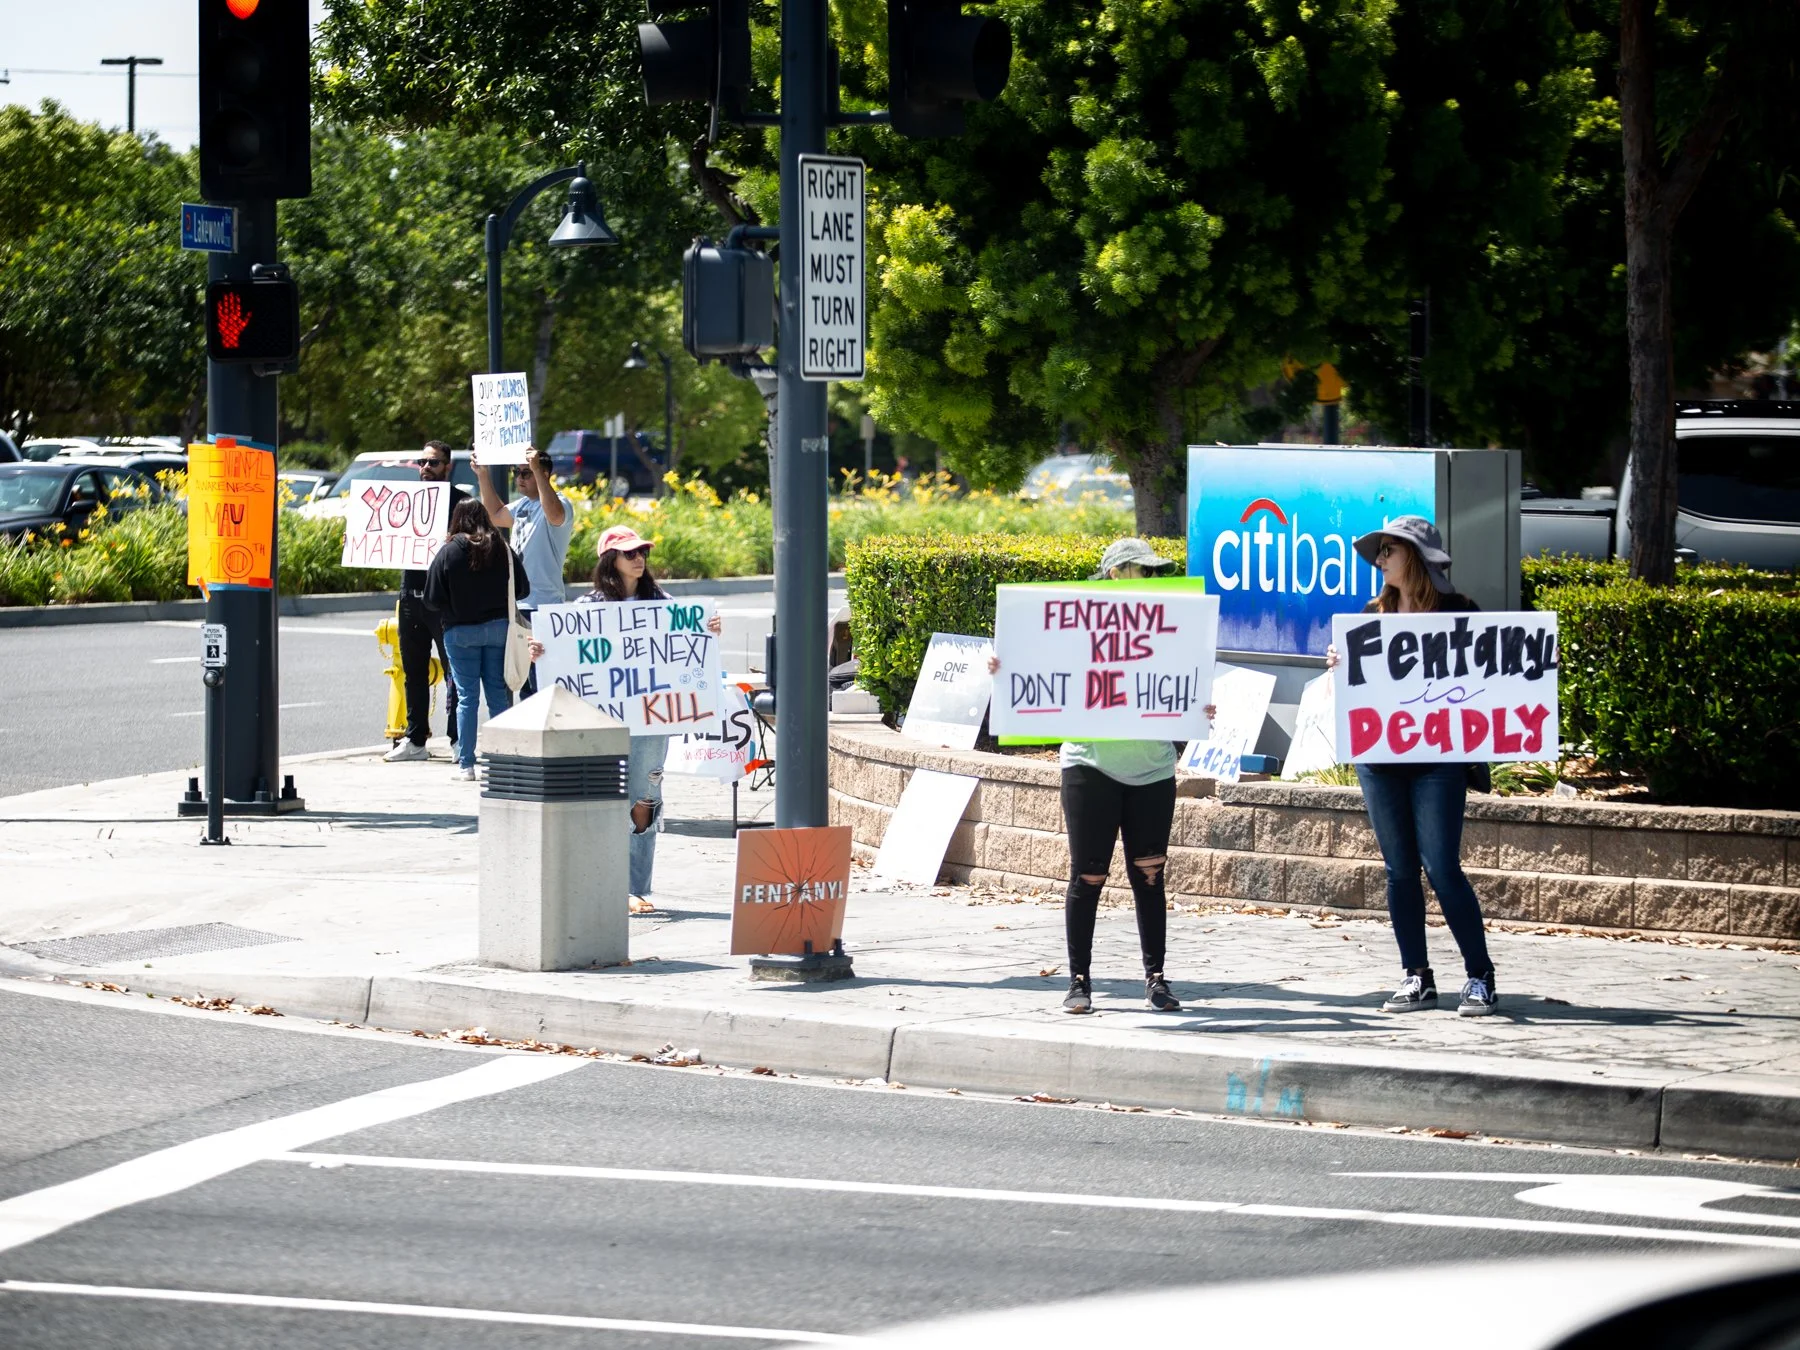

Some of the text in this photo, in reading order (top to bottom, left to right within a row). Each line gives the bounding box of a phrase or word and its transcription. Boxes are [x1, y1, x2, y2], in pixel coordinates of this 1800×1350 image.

[808, 168, 856, 200] RIGHT
[193, 211, 224, 245] Lakewood
[811, 211, 854, 242] LANE
[811, 254, 854, 284] MUST
[812, 296, 854, 326] TURN
[809, 338, 856, 368] RIGHT
[479, 381, 494, 399] OUR
[504, 401, 525, 423] DYING
[205, 503, 245, 537] MAY
[361, 485, 440, 537] YOU
[351, 534, 438, 565] MATTER
[1213, 512, 1389, 597] citiban
[550, 603, 705, 638] DONT LET YOUR
[1044, 600, 1178, 633] FENTANYL
[577, 633, 712, 668] KID BE NEXT
[1090, 631, 1154, 663] KILLS
[933, 671, 955, 683] PILL
[944, 661, 968, 673] ONE
[609, 667, 671, 699] PILL
[1011, 672, 1072, 708] DONT
[1085, 669, 1127, 710] DIE
[1400, 682, 1486, 704] is
[641, 692, 714, 725] KILL
[730, 747, 746, 763] DAY
[742, 880, 844, 904] FENTANYL
